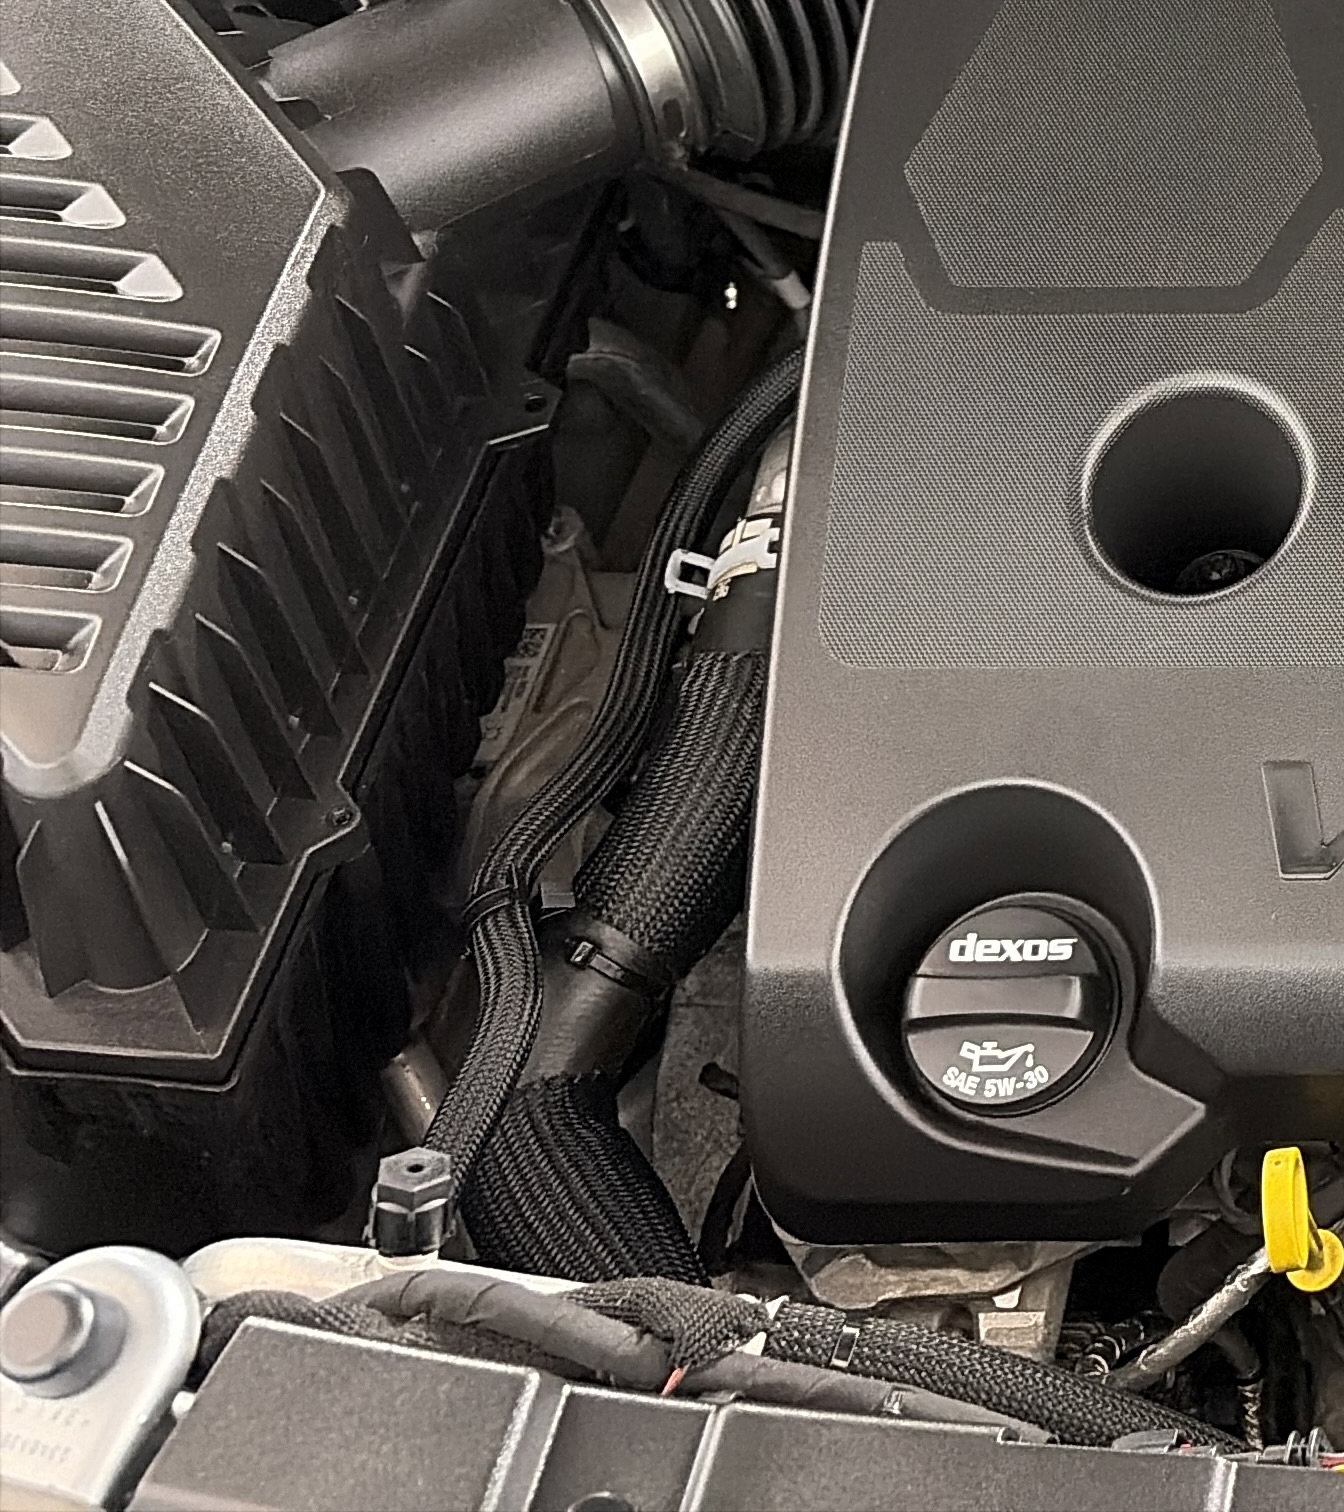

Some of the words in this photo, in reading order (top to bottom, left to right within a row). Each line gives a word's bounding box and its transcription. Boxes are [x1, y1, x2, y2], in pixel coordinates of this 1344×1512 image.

[949, 932, 1078, 962] dexos
[942, 1066, 981, 1096] SAE
[983, 1064, 1049, 1097] 5W-30
